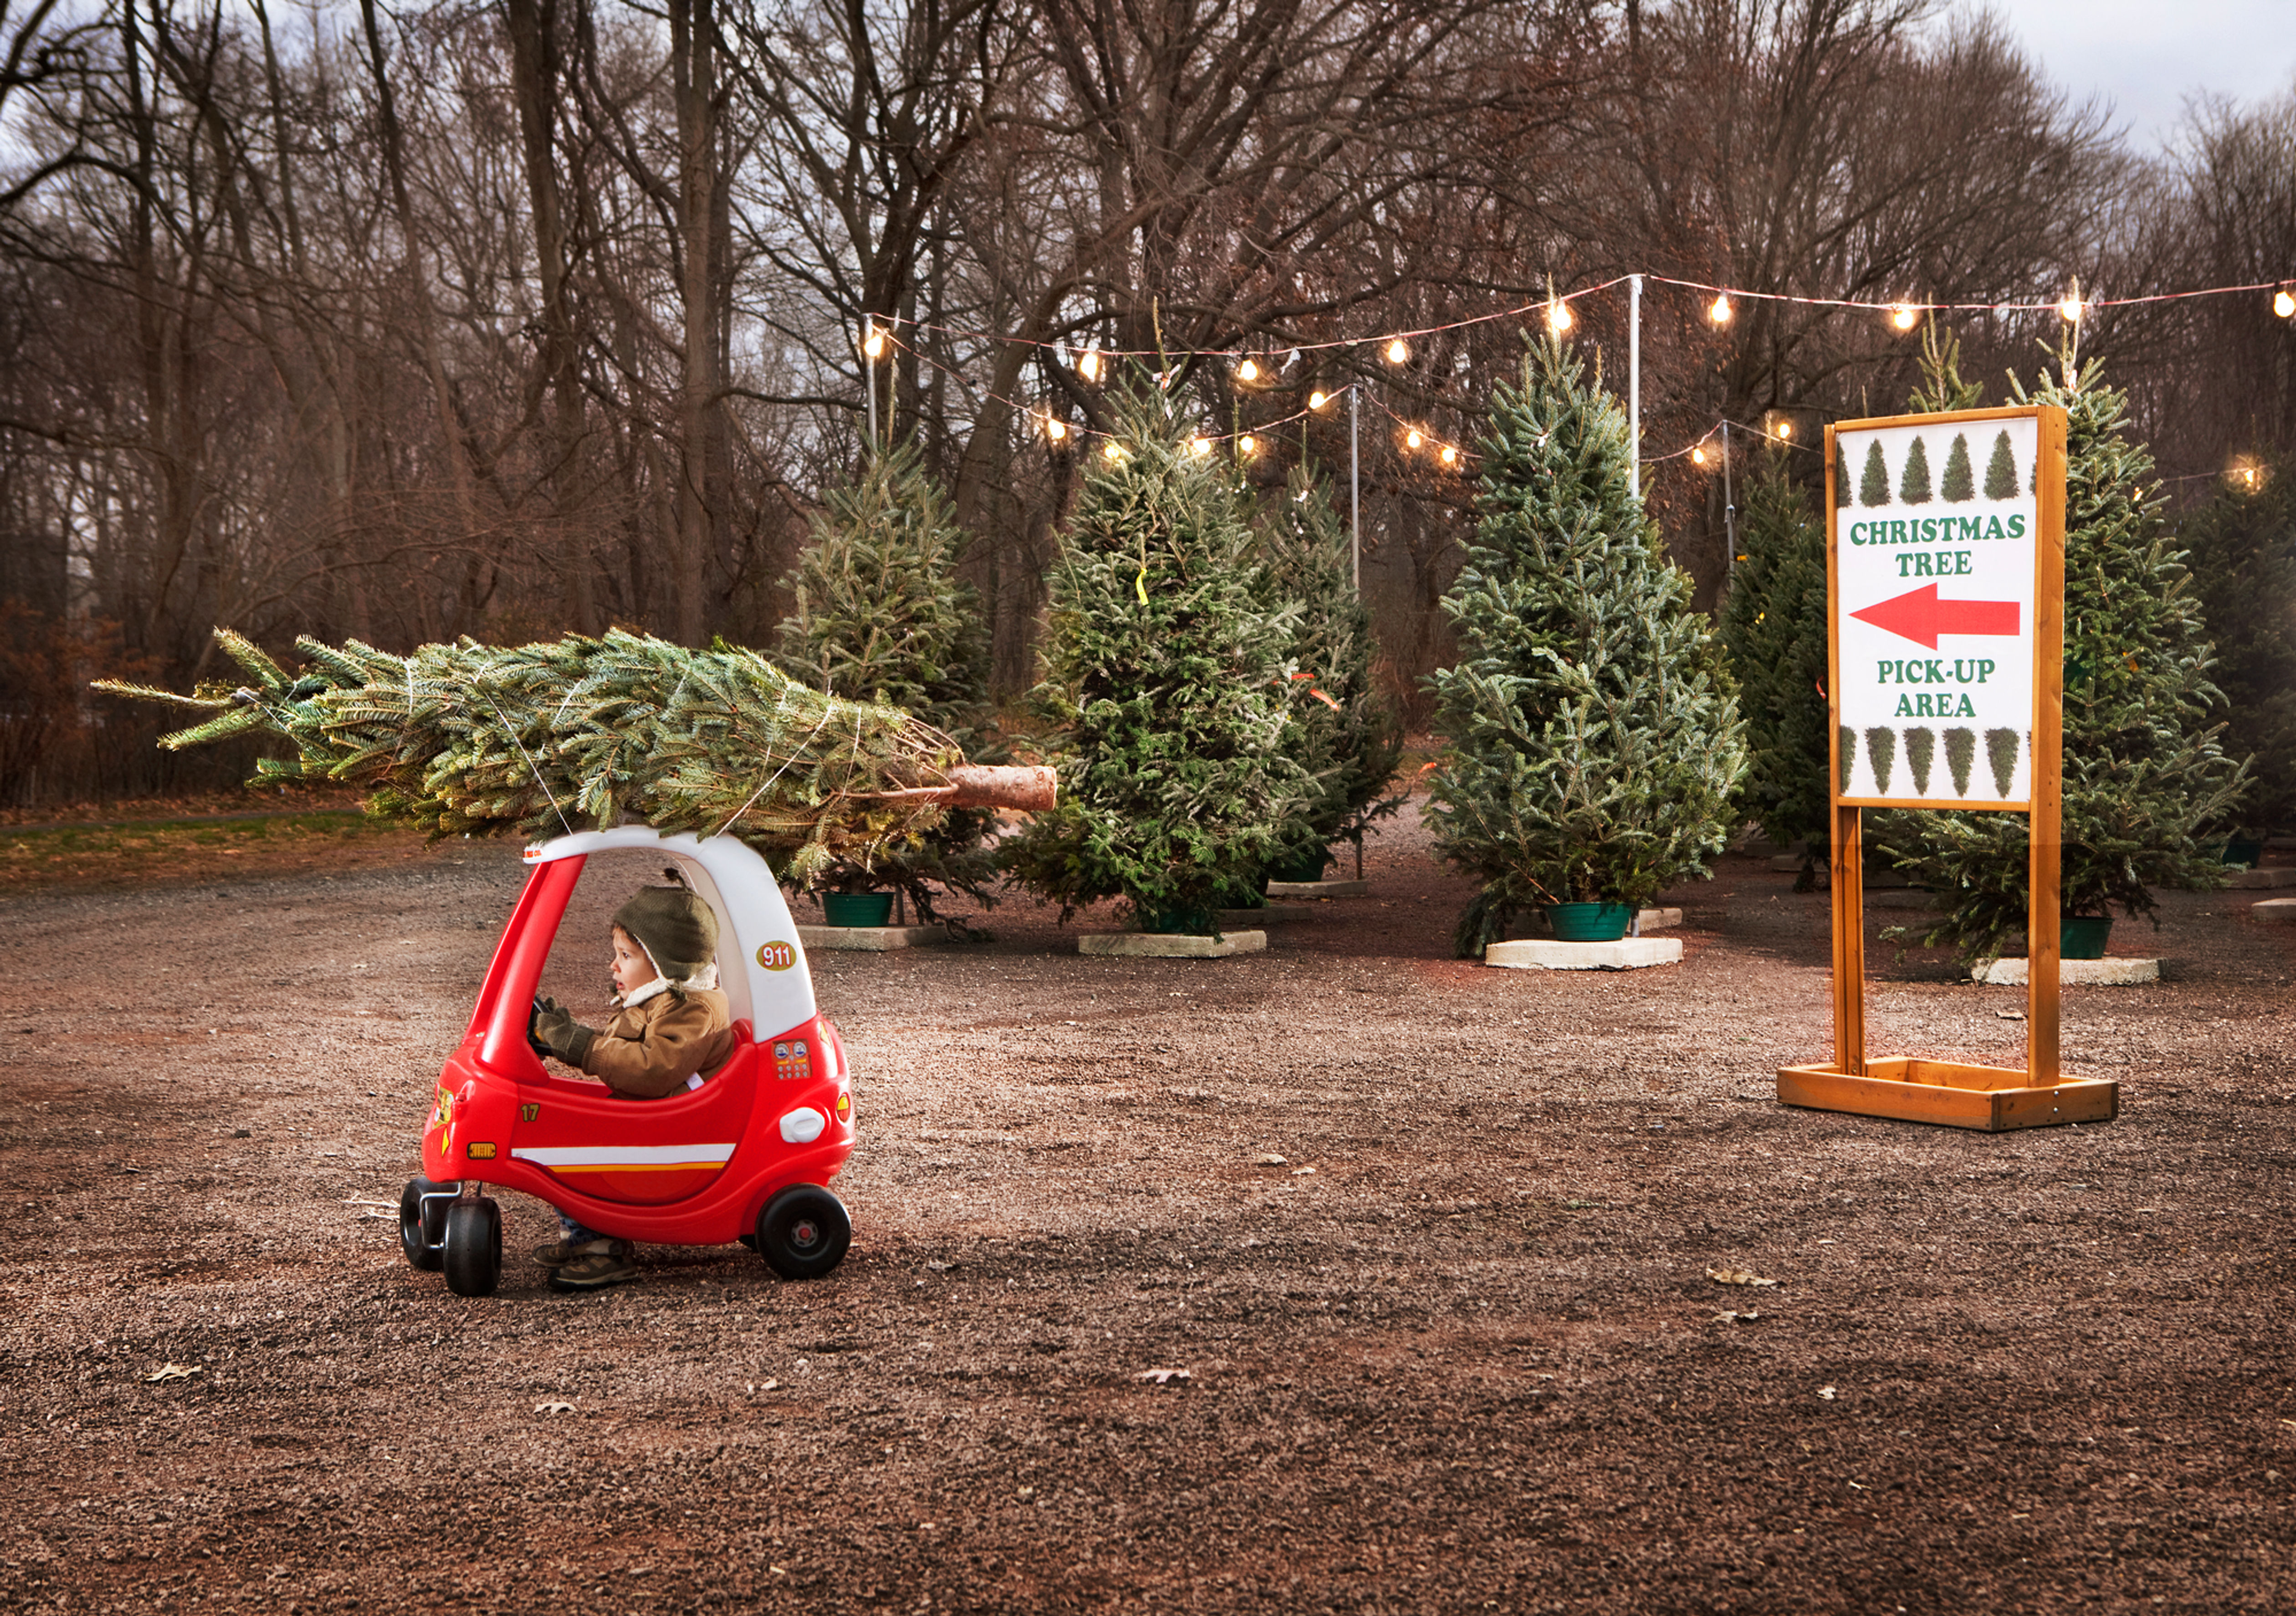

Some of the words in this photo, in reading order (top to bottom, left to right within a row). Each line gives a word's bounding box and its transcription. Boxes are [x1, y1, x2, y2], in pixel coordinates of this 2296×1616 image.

[1850, 514, 2025, 546] CHRISTMAS
[1895, 550, 1973, 577] TREE
[1877, 659, 1995, 684] PICK-UP
[1894, 693, 1976, 718] AREA
[762, 944, 791, 967] 911
[521, 1103, 540, 1122] 17
